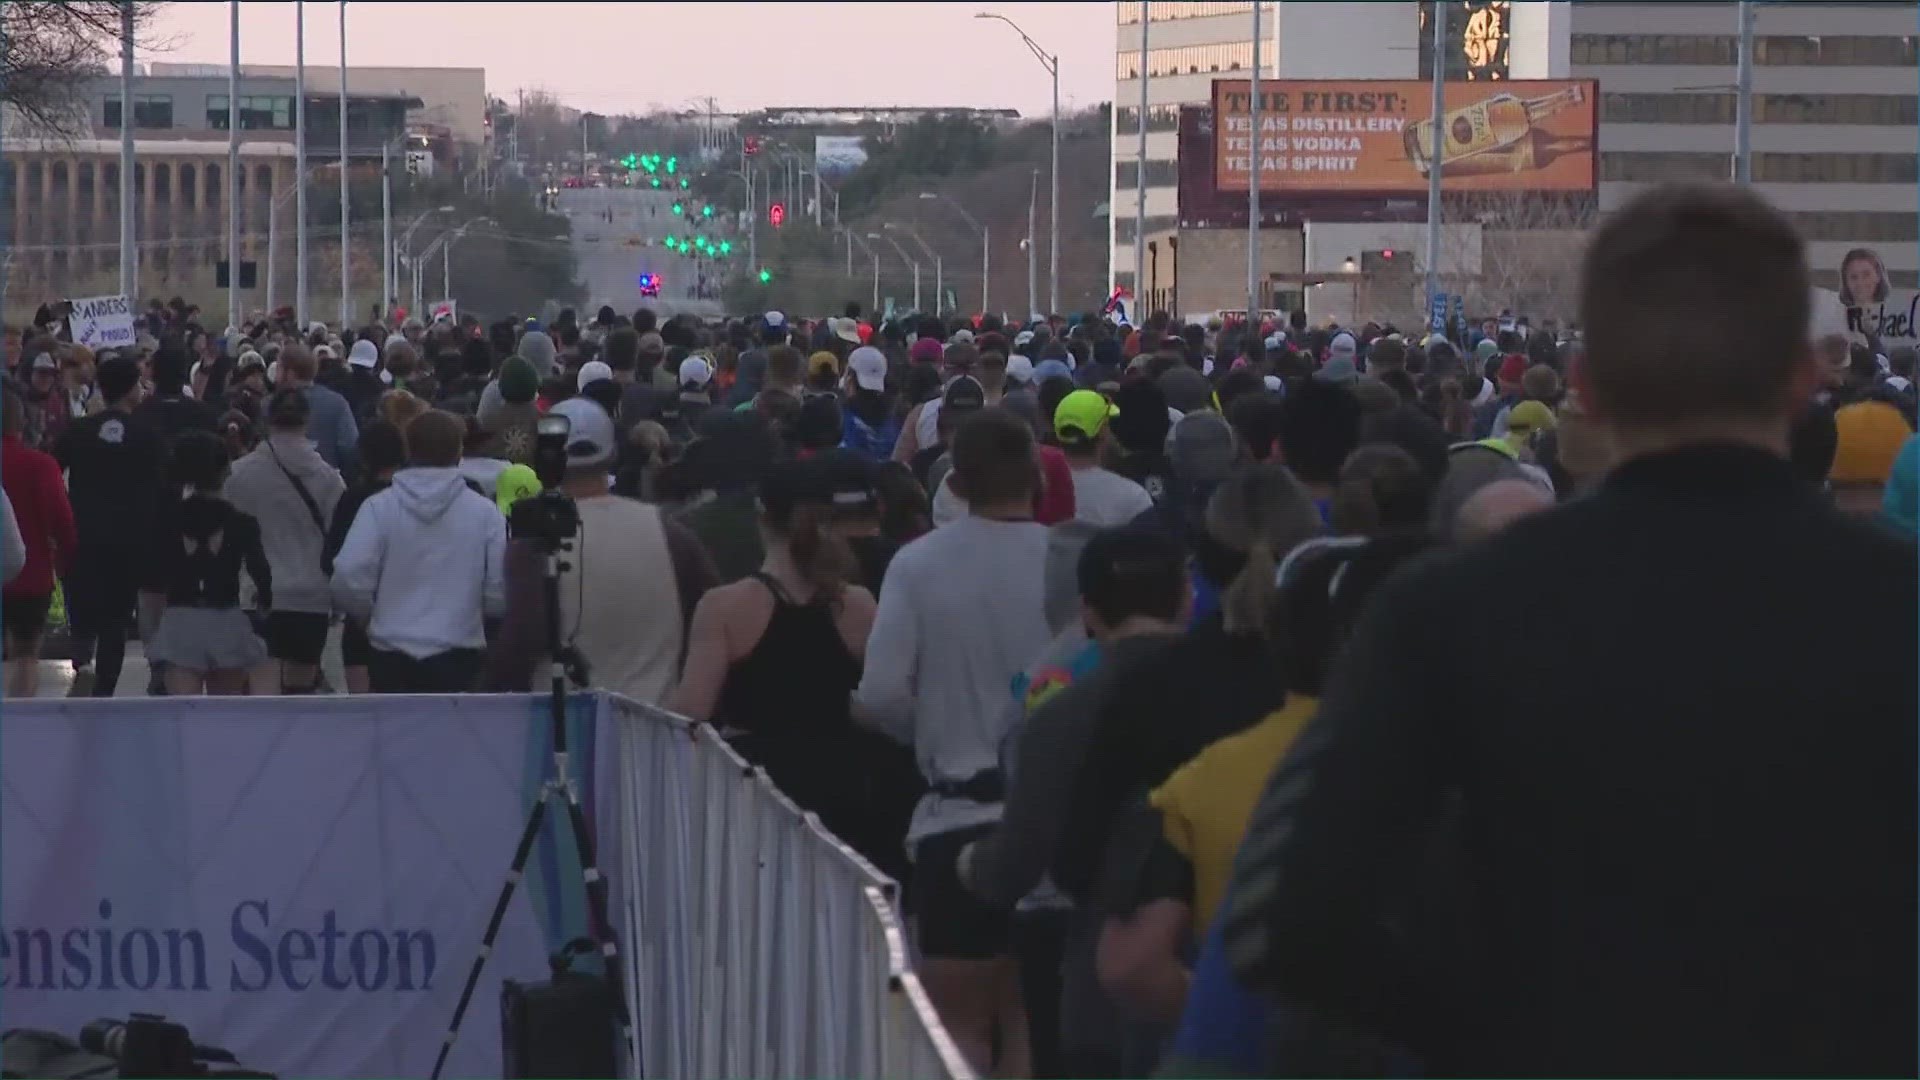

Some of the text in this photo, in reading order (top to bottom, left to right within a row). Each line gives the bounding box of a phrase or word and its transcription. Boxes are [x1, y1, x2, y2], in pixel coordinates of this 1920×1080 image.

[1225, 92, 1407, 112] THE FIRST:
[1292, 117, 1405, 132] DISTILLERY
[1292, 137, 1362, 151] VODKA
[1292, 157, 1357, 171] SPIRIT
[230, 898, 436, 993] Seton
